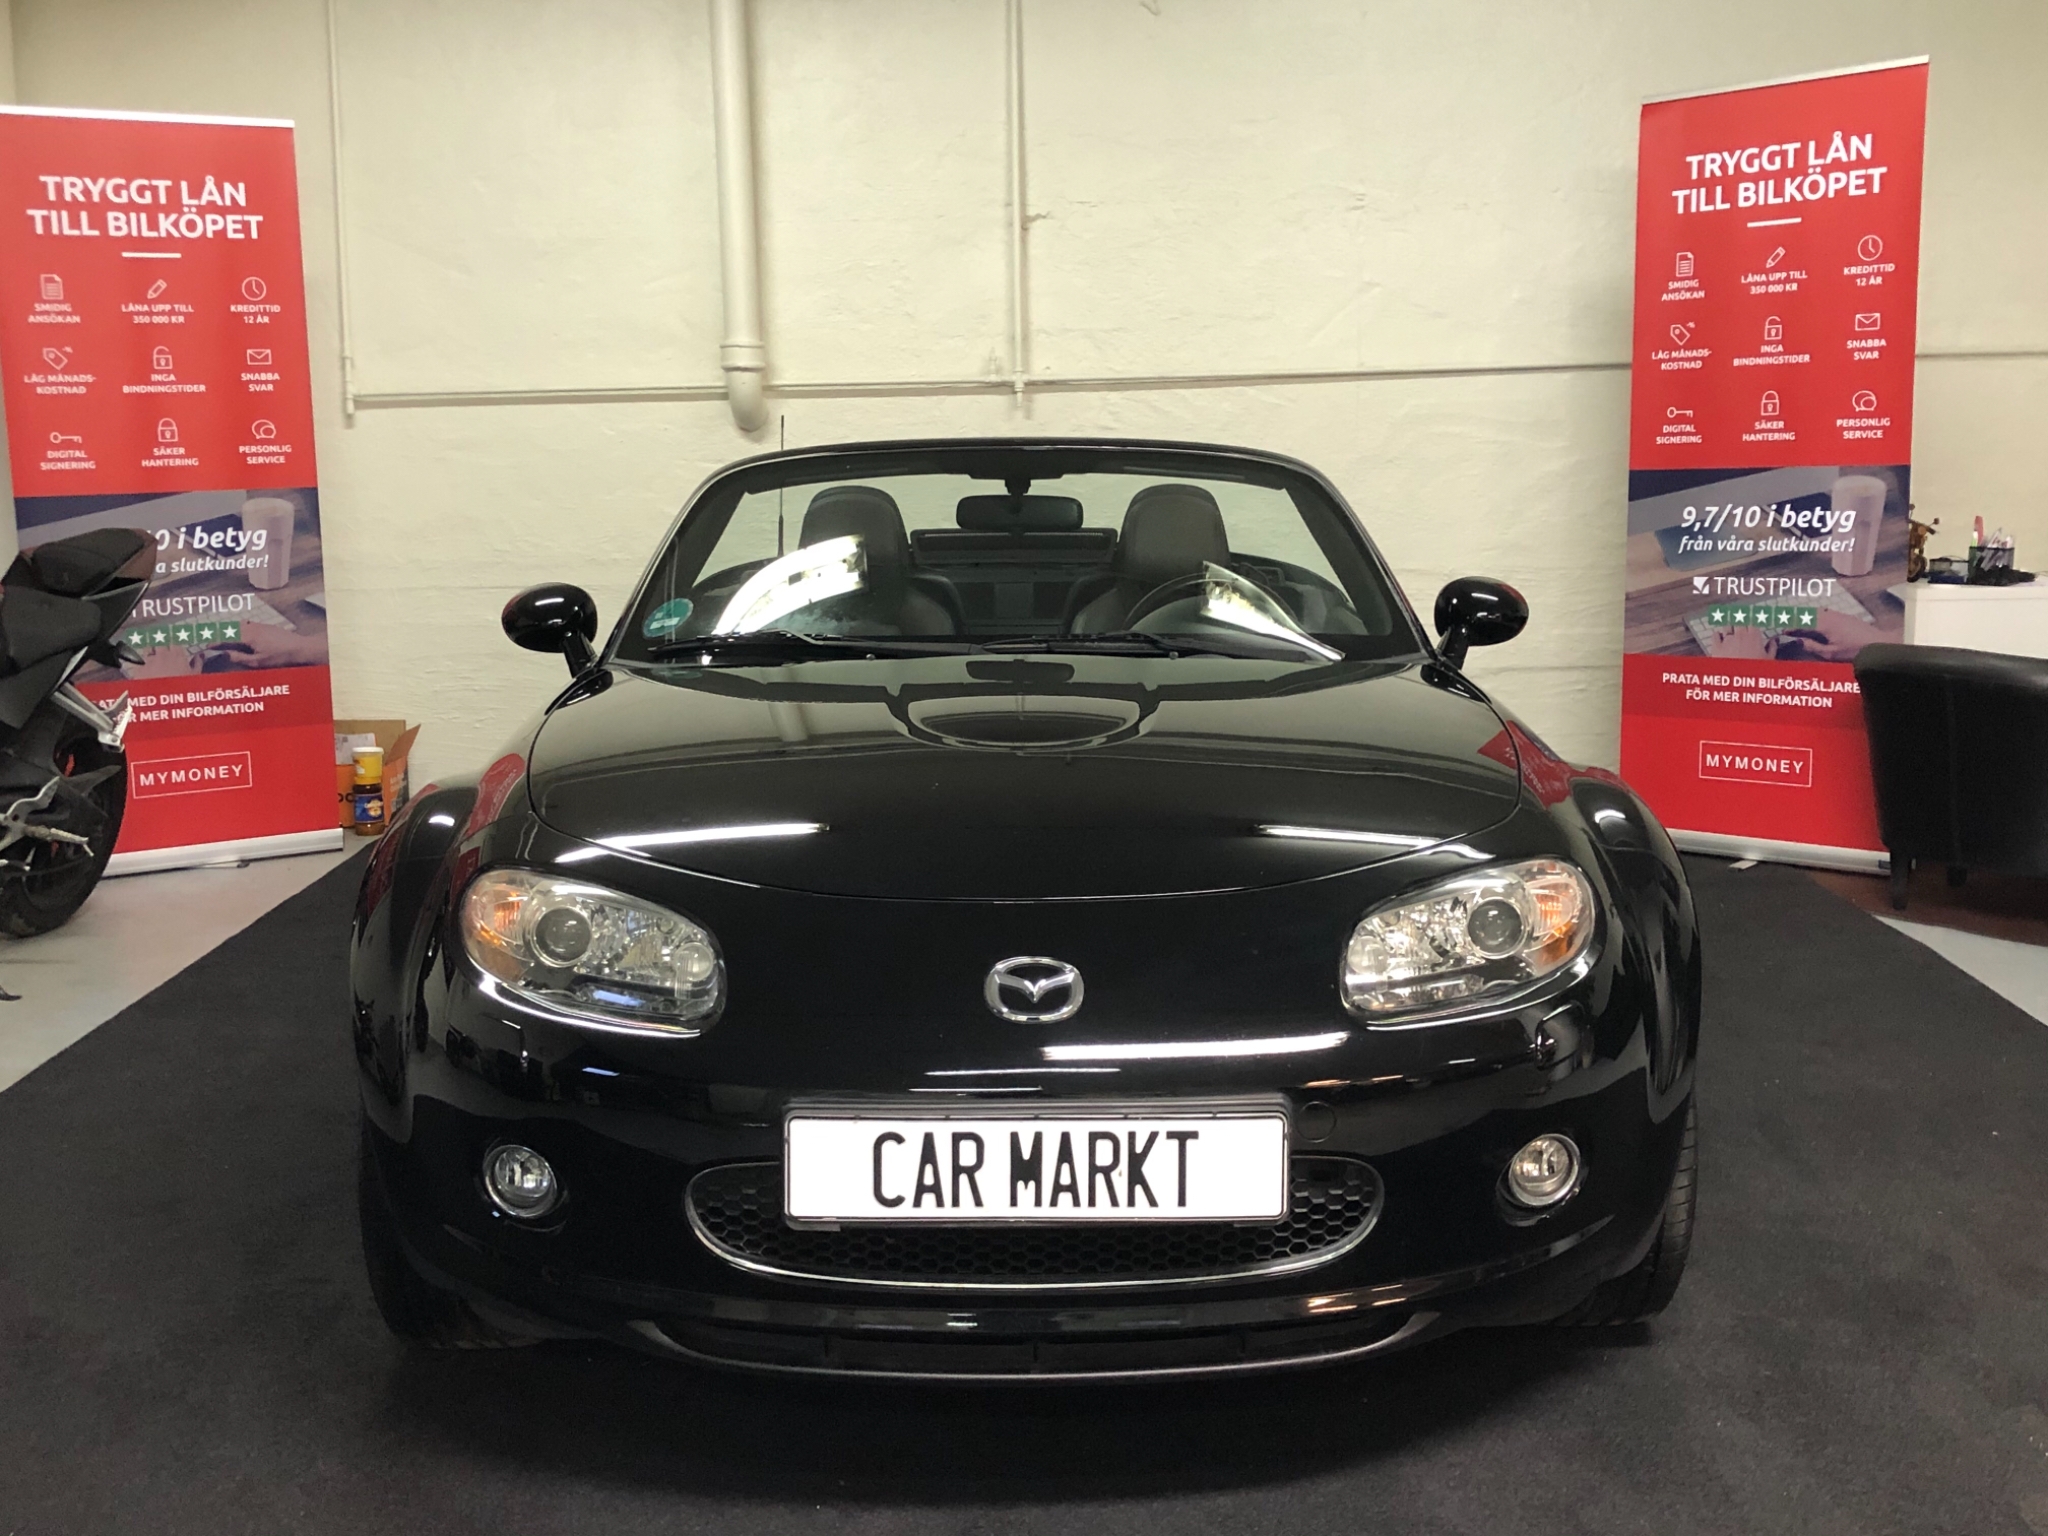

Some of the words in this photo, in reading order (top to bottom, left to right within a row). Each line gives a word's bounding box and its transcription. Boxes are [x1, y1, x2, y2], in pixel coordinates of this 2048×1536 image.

[1686, 142, 1801, 180] TRYGGT
[1807, 130, 1873, 167] LÅN
[39, 175, 172, 204] TRYGGT
[180, 175, 247, 207] LÅN
[1672, 184, 1730, 215] TILL
[1738, 166, 1888, 208] BILKÖPET
[26, 209, 99, 236] TILL
[107, 207, 263, 239] BILKÖPET
[1843, 263, 1896, 276] KREDITTID
[1741, 272, 1766, 284] LÅNA
[1769, 271, 1787, 282] UPP
[1789, 270, 1808, 280] TILL
[1856, 277, 1867, 287] 12
[1869, 275, 1883, 285] ÅR
[1668, 279, 1699, 290] SMIDIG
[1785, 282, 1798, 292] KR
[1661, 289, 1705, 301] ANSÖKAN
[34, 302, 72, 313] SMIDIG
[121, 302, 149, 313] LÅNA
[151, 304, 171, 313] UPP
[173, 304, 194, 313] TILL
[230, 304, 281, 313] KREDITTID
[28, 313, 81, 324] ANSÖKAN
[172, 315, 185, 324] KR
[243, 315, 255, 324] 12
[256, 313, 270, 324] ÅR
[1760, 344, 1784, 354] INGA
[1846, 338, 1887, 349] SNABBA
[1651, 349, 1670, 361] LÅG
[1671, 348, 1712, 359] MÅNADS-
[1853, 351, 1879, 361] SVAR
[1661, 360, 1703, 371] KOSTNAD
[1733, 354, 1810, 367] BINDNINGSTIDER
[24, 373, 45, 383] LÅG
[48, 373, 97, 383] MÅNADS-
[151, 373, 176, 383] INGA
[240, 372, 280, 382] SNABBA
[36, 385, 87, 395] KOSTNAD
[122, 384, 206, 394] BINDNINGSTIDER
[248, 383, 274, 393] SVAR
[1754, 419, 1785, 430] SÄKER
[1836, 417, 1890, 428] PERSONLIG
[1662, 424, 1696, 434] DIGITAL
[1843, 429, 1883, 440] SERVICE
[1655, 434, 1702, 445] SIGNERING
[1742, 431, 1796, 442] HANTERING
[47, 450, 87, 459] DIGITAL
[153, 445, 185, 456] SÄKER
[239, 444, 292, 454] PERSONLIG
[40, 460, 96, 471] SIGNERING
[141, 457, 199, 467] HANTERING
[246, 455, 286, 465] SERVICE
[1681, 504, 1761, 533] 9,7/10
[1766, 504, 1777, 528] i
[1781, 504, 1857, 533] betyg
[178, 527, 187, 549] i
[193, 526, 267, 552] betyg
[1678, 535, 1713, 554] från
[1717, 535, 1755, 552] våra
[1758, 536, 1855, 553] slutkunder!
[170, 554, 269, 573] slutkunder!
[1713, 576, 1836, 597] TRUSTPILOT
[1662, 673, 1700, 687] PRATA
[1702, 675, 1731, 687] MED
[1733, 676, 1756, 688] DIN
[1758, 677, 1861, 694] BILFÖRSÄLJARE
[127, 695, 157, 707] MED
[160, 693, 184, 705] DIN
[187, 684, 290, 703] BILFÖRSÄLJARE
[1686, 687, 1710, 701] FÖR
[1712, 691, 1740, 703] MER
[1742, 692, 1833, 708] INFORMATION
[139, 710, 169, 722] MER
[172, 701, 265, 719] INFORMATION
[1705, 754, 1805, 775] MYMONEY
[139, 764, 243, 787] MYMONEY
[872, 1131, 985, 1208] CAR
[1009, 1130, 1199, 1208] MARKT
